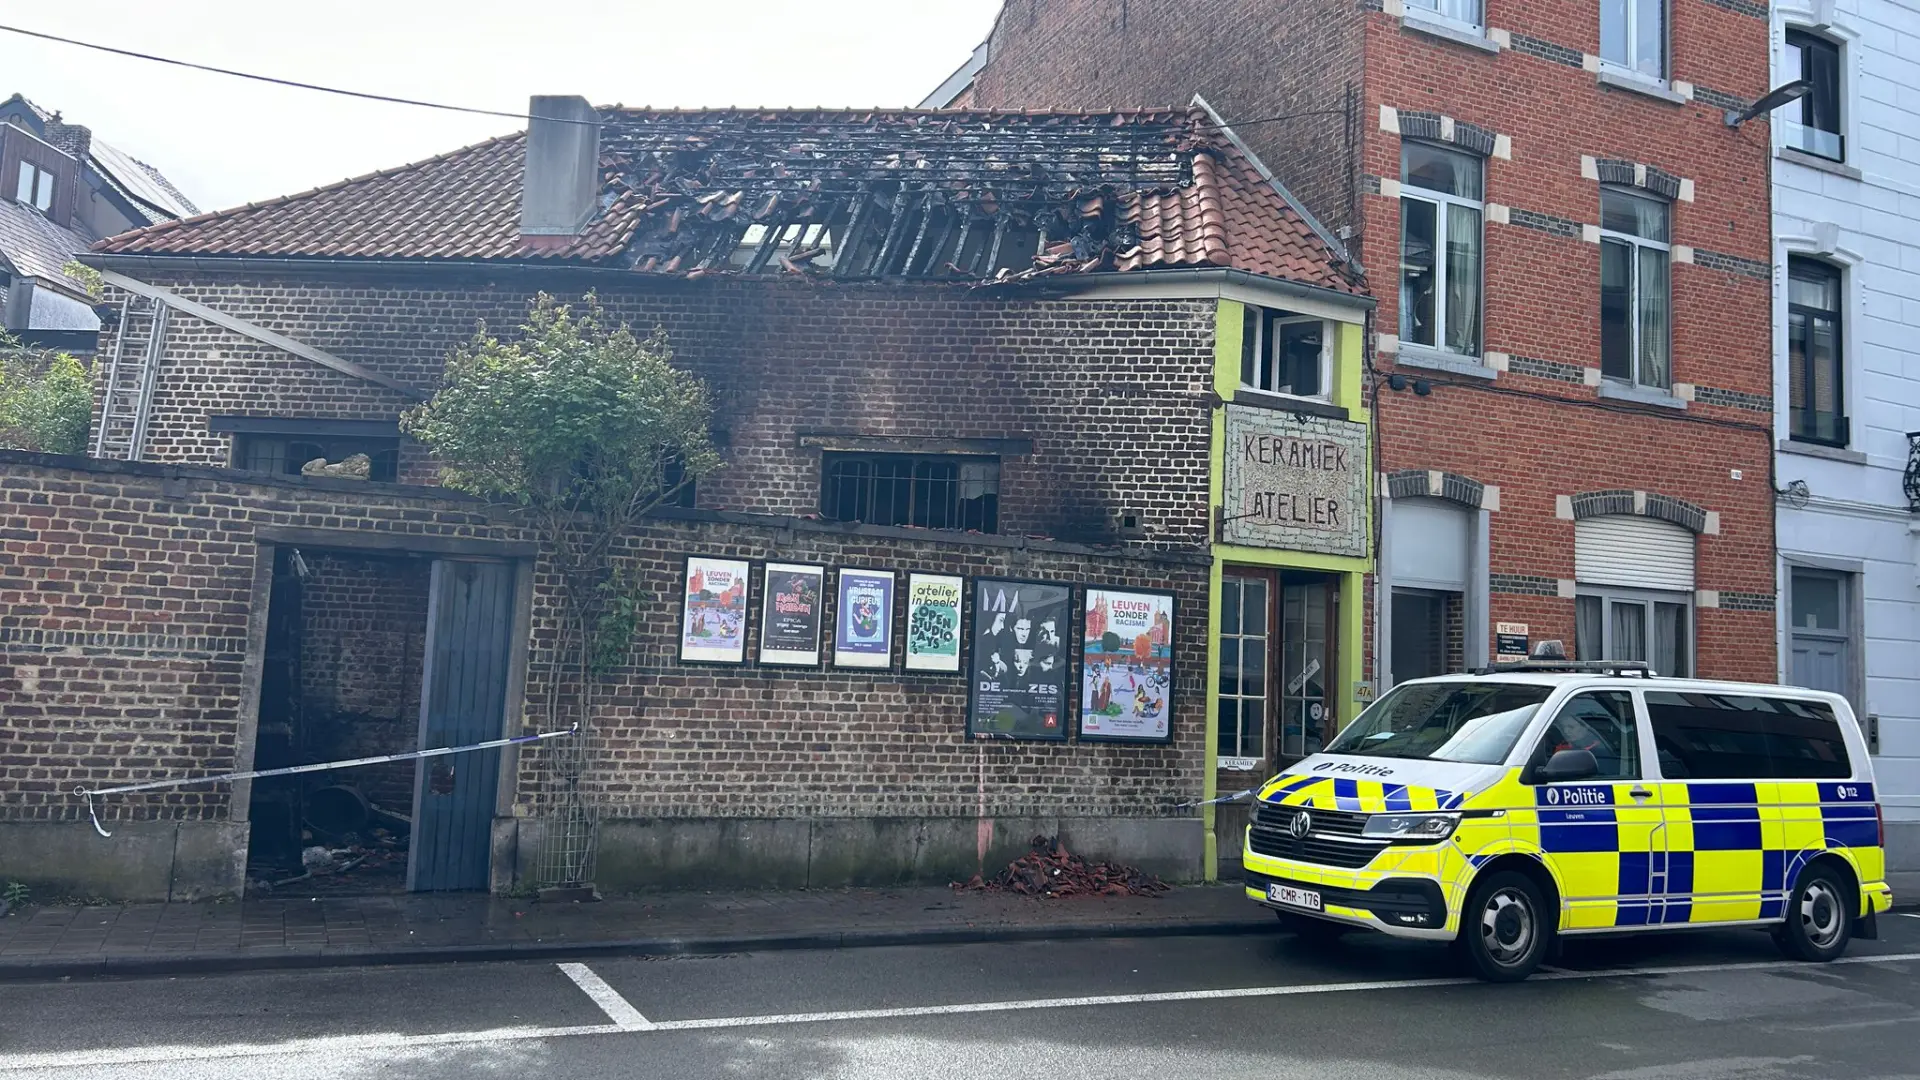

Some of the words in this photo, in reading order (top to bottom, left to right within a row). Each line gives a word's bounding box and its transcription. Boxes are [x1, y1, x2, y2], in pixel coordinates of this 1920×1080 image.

[1245, 435, 1347, 471] KERAMIEK
[1254, 491, 1339, 525] ATELIER
[706, 570, 732, 578] LEUVEN
[917, 584, 957, 597] atelier
[911, 594, 922, 605] in
[923, 596, 959, 608] beeld
[1111, 600, 1151, 612] LEUVEN
[919, 606, 951, 629] OPEN
[1113, 610, 1148, 621] ZONDER
[911, 612, 953, 642] STUDIO
[1115, 619, 1146, 627] RACISME
[1500, 624, 1509, 633] TE
[911, 624, 940, 649] DAYS
[980, 681, 1001, 692] DE
[1028, 683, 1058, 694] ZES
[1331, 763, 1394, 777] Politie
[1563, 787, 1606, 804] Politie
[1845, 786, 1859, 797] 112
